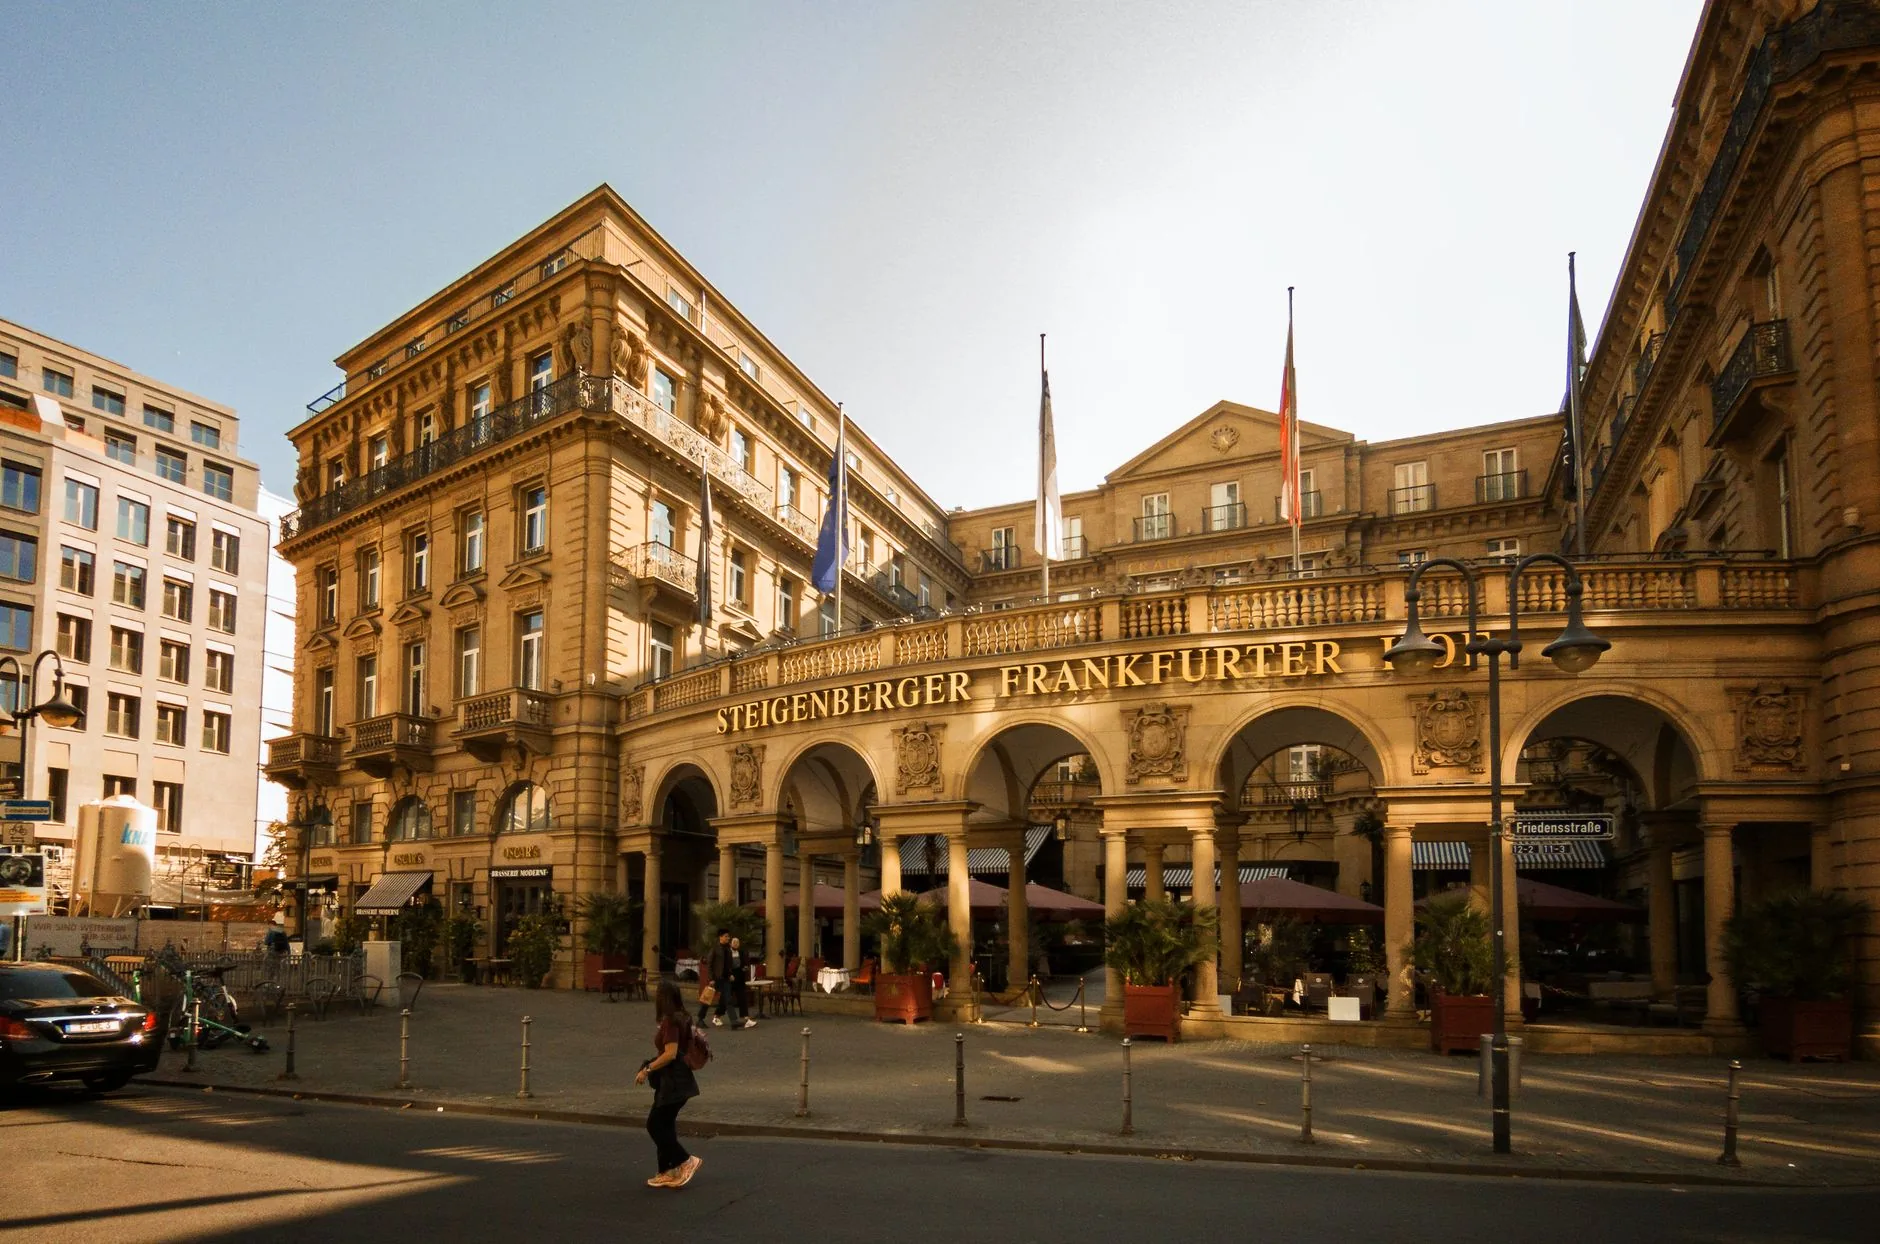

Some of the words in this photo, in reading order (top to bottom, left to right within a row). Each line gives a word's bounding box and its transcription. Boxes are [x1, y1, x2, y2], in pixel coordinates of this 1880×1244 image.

[717, 671, 971, 734] STEIGENBERGER
[1000, 641, 1344, 697] FRANKFURTER
[1516, 821, 1601, 833] Friedensstraße
[1513, 845, 1534, 853] 12-2
[1544, 845, 1565, 853] 11-3
[520, 869, 548, 877] MODERNE
